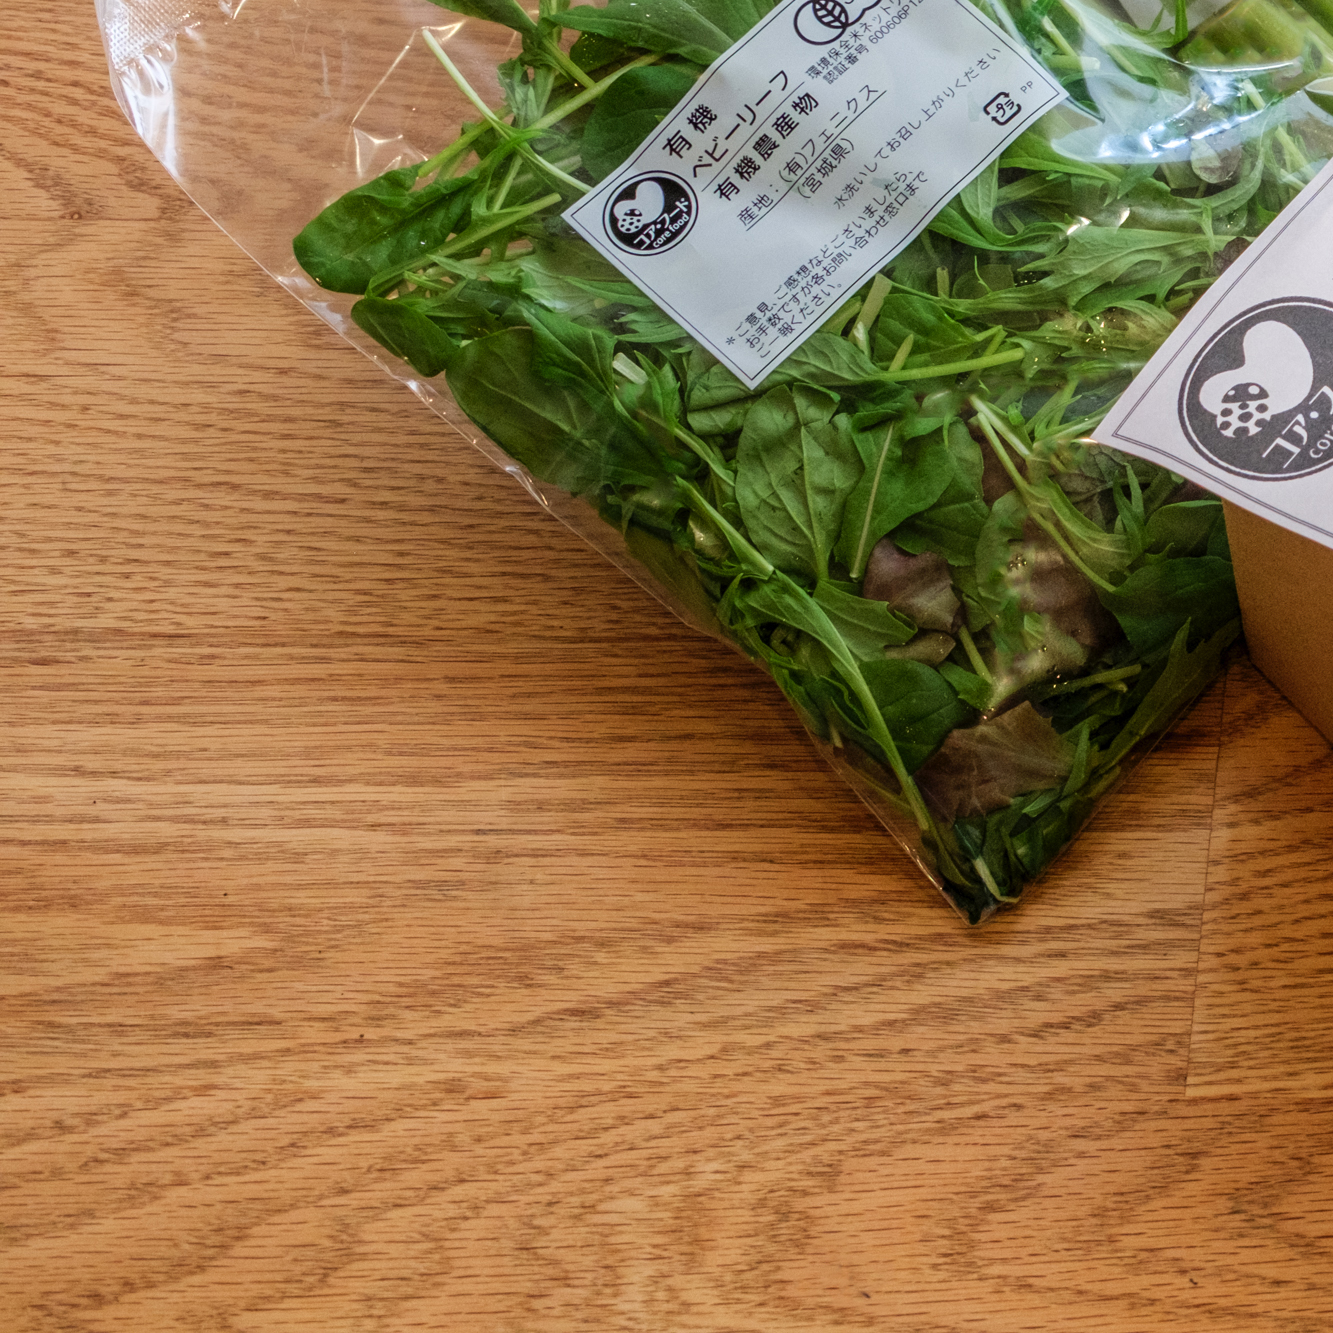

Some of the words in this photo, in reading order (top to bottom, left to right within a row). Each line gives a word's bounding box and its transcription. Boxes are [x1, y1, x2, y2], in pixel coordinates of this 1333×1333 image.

[823, 44, 869, 84] 認証番号
[1020, 81, 1033, 93] PP
[662, 104, 717, 159] 有機
[693, 70, 788, 178] ベビーリーフ
[834, 49, 1000, 209] 水洗いしてお召し上がりください
[992, 95, 1016, 119] プラ
[714, 93, 819, 201] 有機農産物
[634, 196, 690, 250] コア・フード
[651, 228, 673, 250] core
[668, 212, 690, 233] food
[746, 171, 927, 348] お手数ですが各お問い合わせ窓口まで
[757, 284, 841, 358] ご一報ください。
